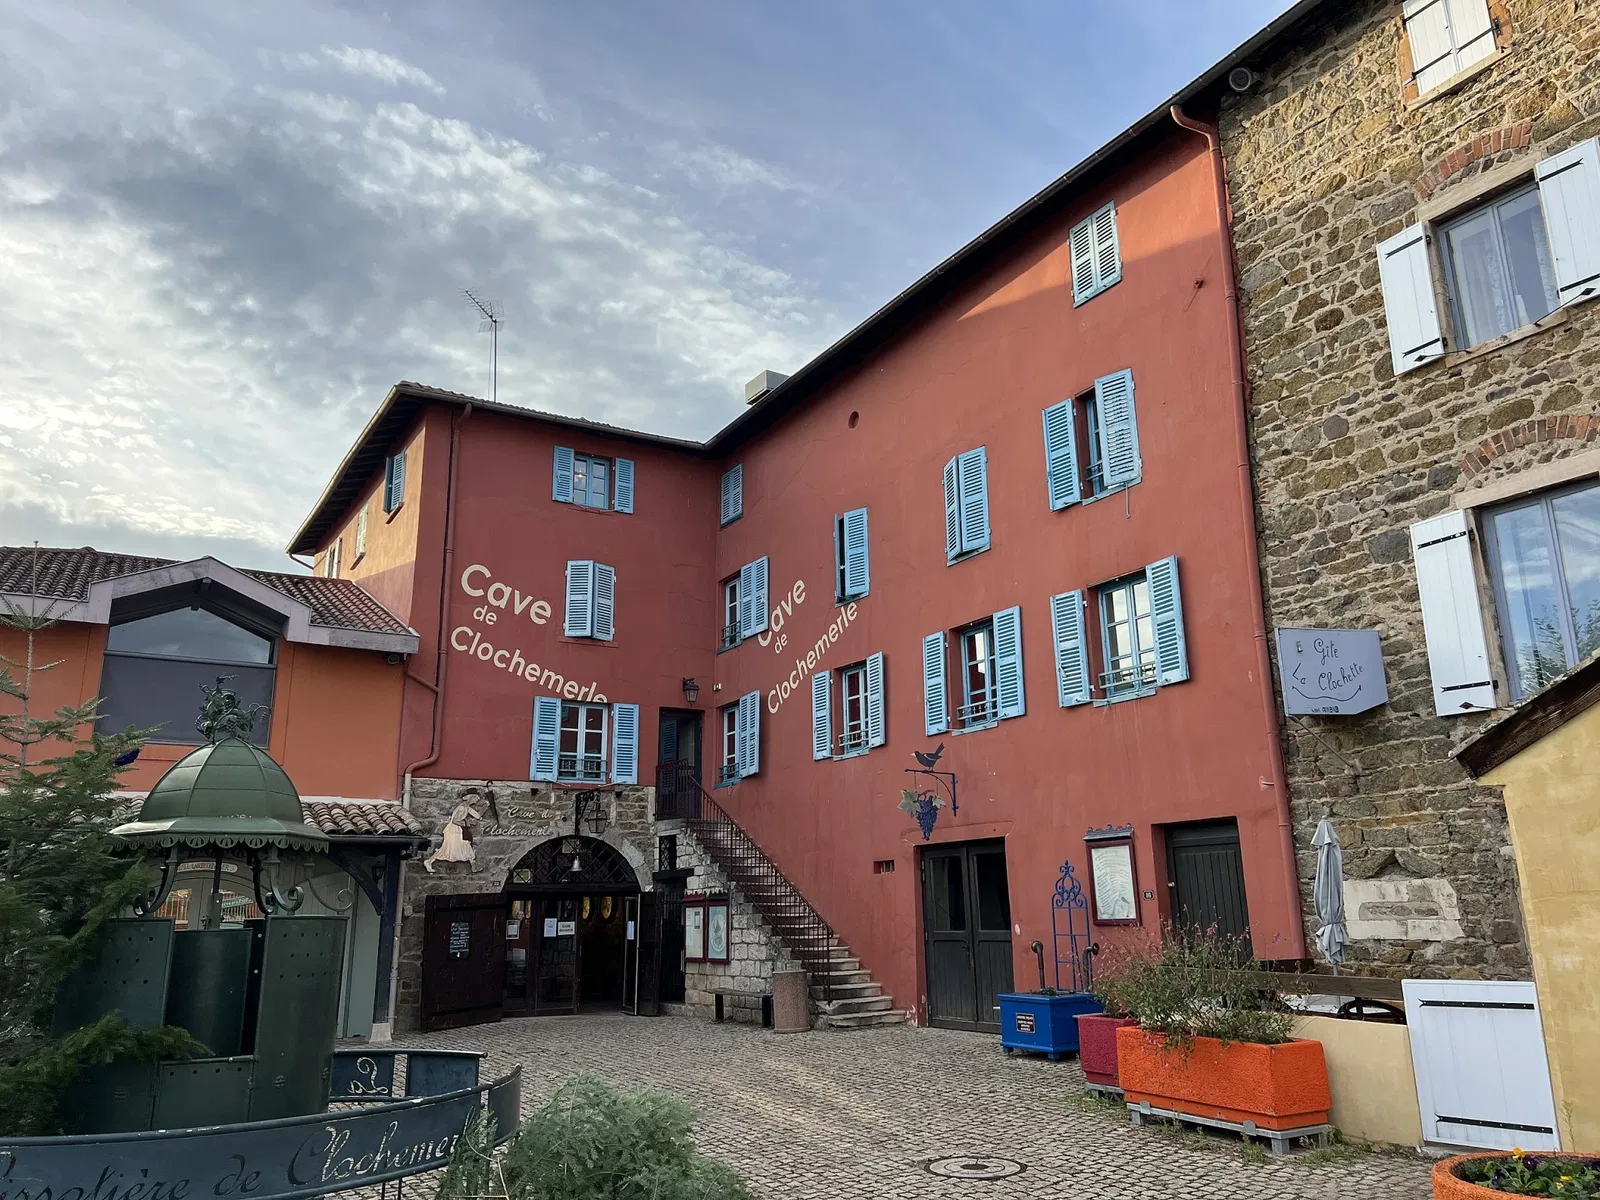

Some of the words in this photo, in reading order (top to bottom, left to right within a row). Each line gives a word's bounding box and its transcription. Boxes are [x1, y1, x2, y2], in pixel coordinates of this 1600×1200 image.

[461, 564, 552, 625] Cave
[473, 605, 497, 625] de
[767, 602, 858, 714] Clochemerle
[774, 633, 788, 654] de
[1292, 663, 1306, 685] La
[1318, 663, 1363, 691] Clochette
[213, 1154, 261, 1195] de
[286, 1106, 477, 1186] Clochemerl
